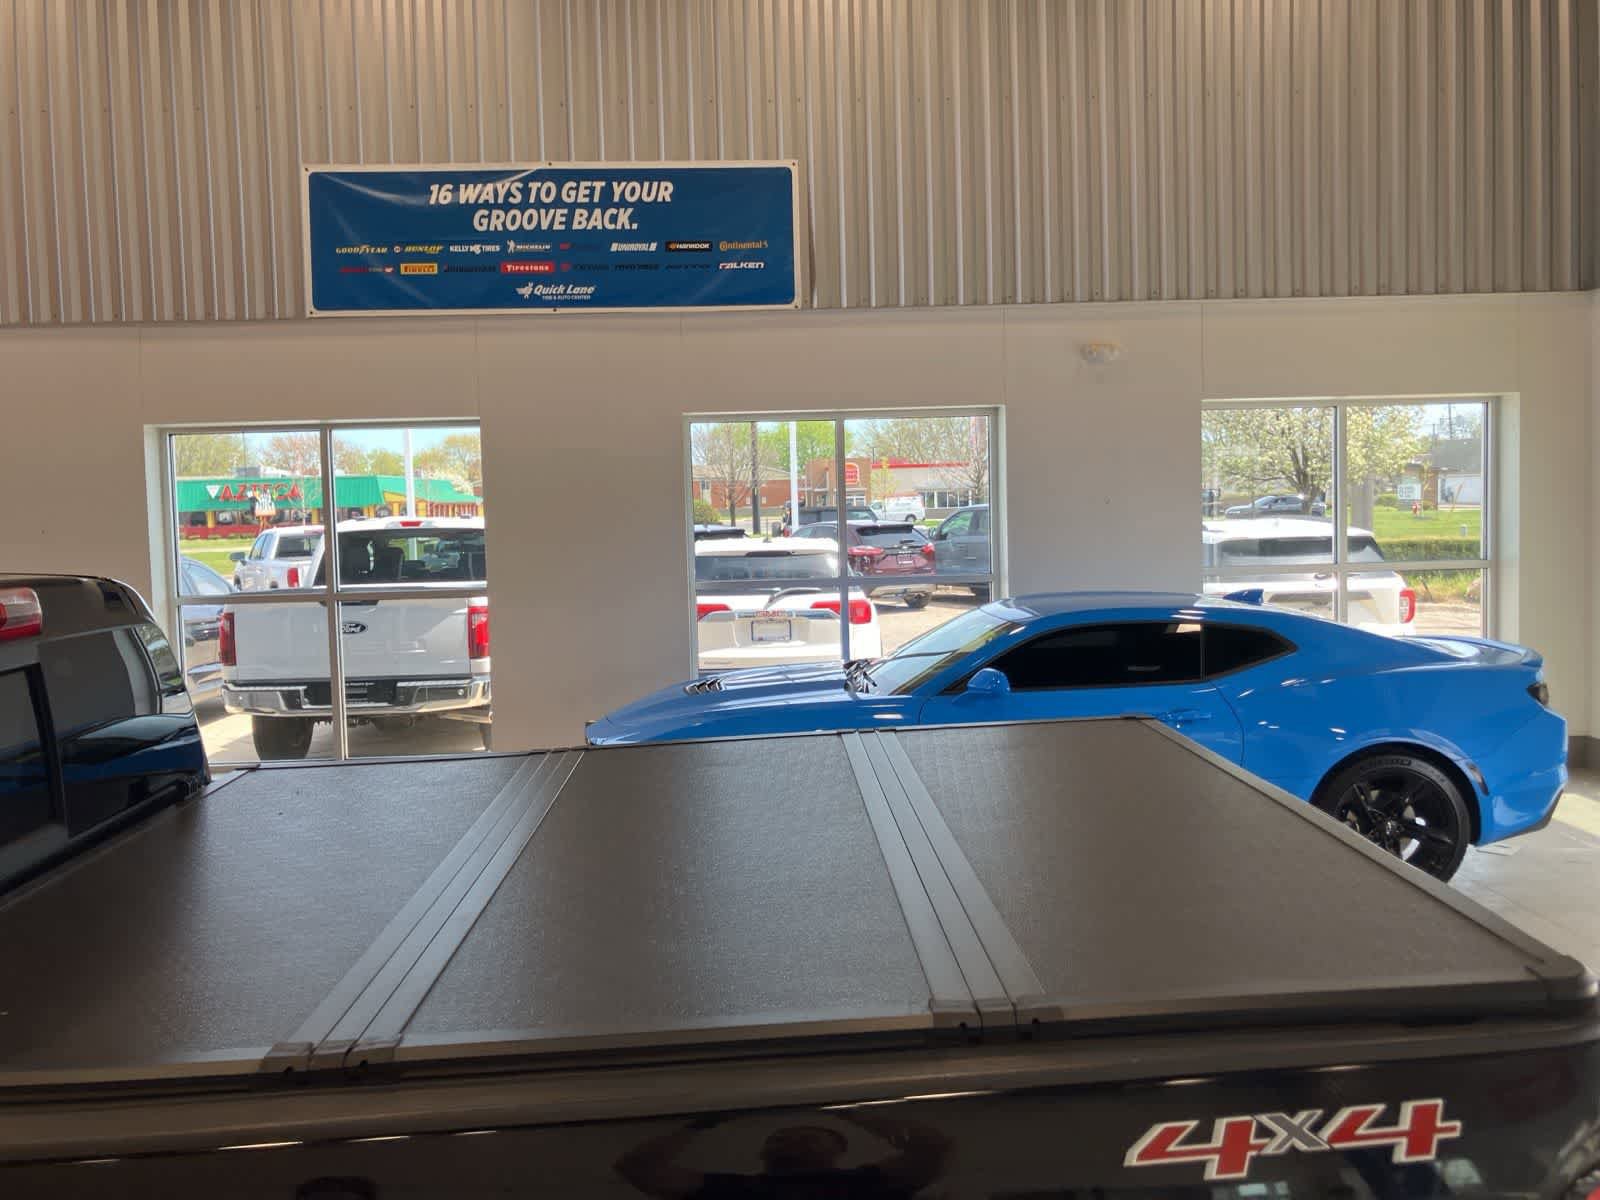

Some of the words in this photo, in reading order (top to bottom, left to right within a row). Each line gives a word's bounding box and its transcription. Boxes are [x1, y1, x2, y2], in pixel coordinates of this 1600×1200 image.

[429, 183, 454, 205] 16
[459, 181, 524, 204] WAYS
[528, 181, 557, 204] TO
[561, 181, 606, 203] GET
[612, 181, 674, 203] YOUR
[473, 208, 568, 232] GROOVE
[572, 207, 638, 231] BACK.
[533, 284, 565, 296] Quick
[566, 284, 595, 294] Lane
